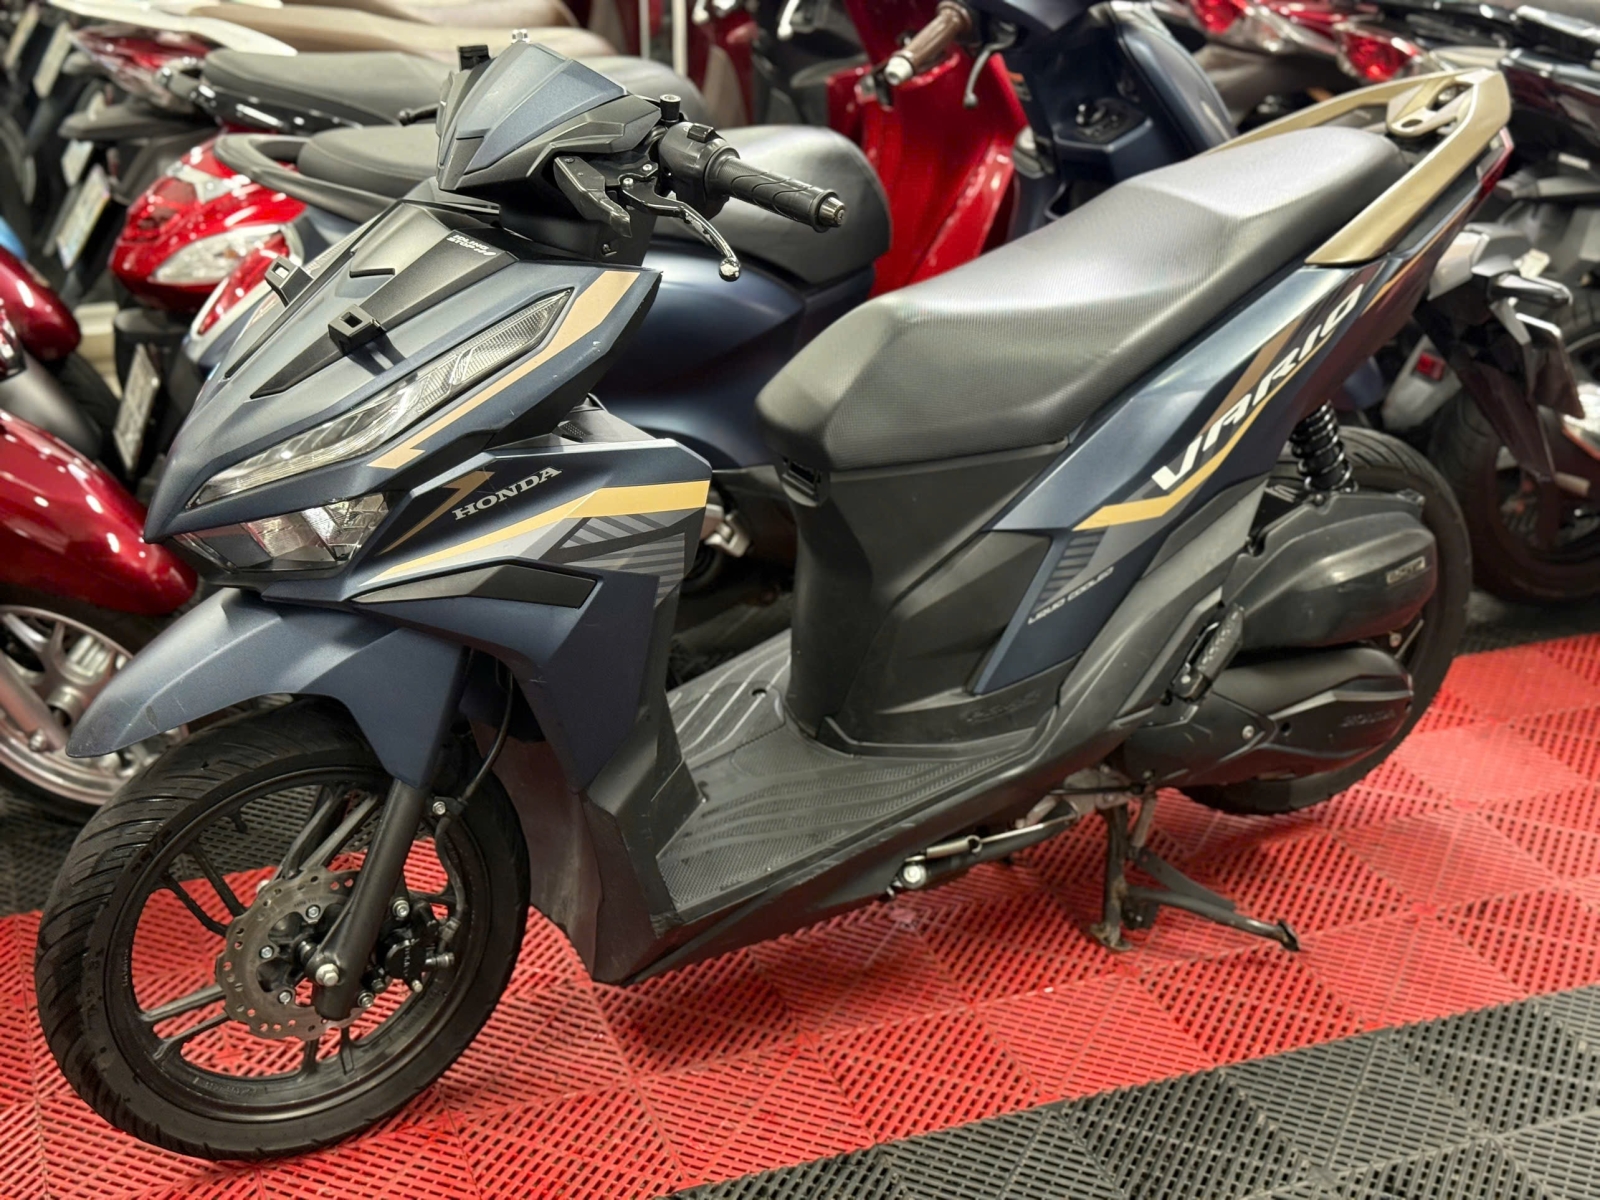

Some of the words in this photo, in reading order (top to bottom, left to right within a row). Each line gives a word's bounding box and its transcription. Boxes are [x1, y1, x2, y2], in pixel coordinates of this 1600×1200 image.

[446, 237, 476, 249] STOP
[452, 234, 490, 250] IDLING
[1151, 283, 1365, 491] VARIO
[451, 467, 562, 520] HONDA
[1027, 597, 1066, 625] LIQUID
[1067, 565, 1115, 602] COOLED
